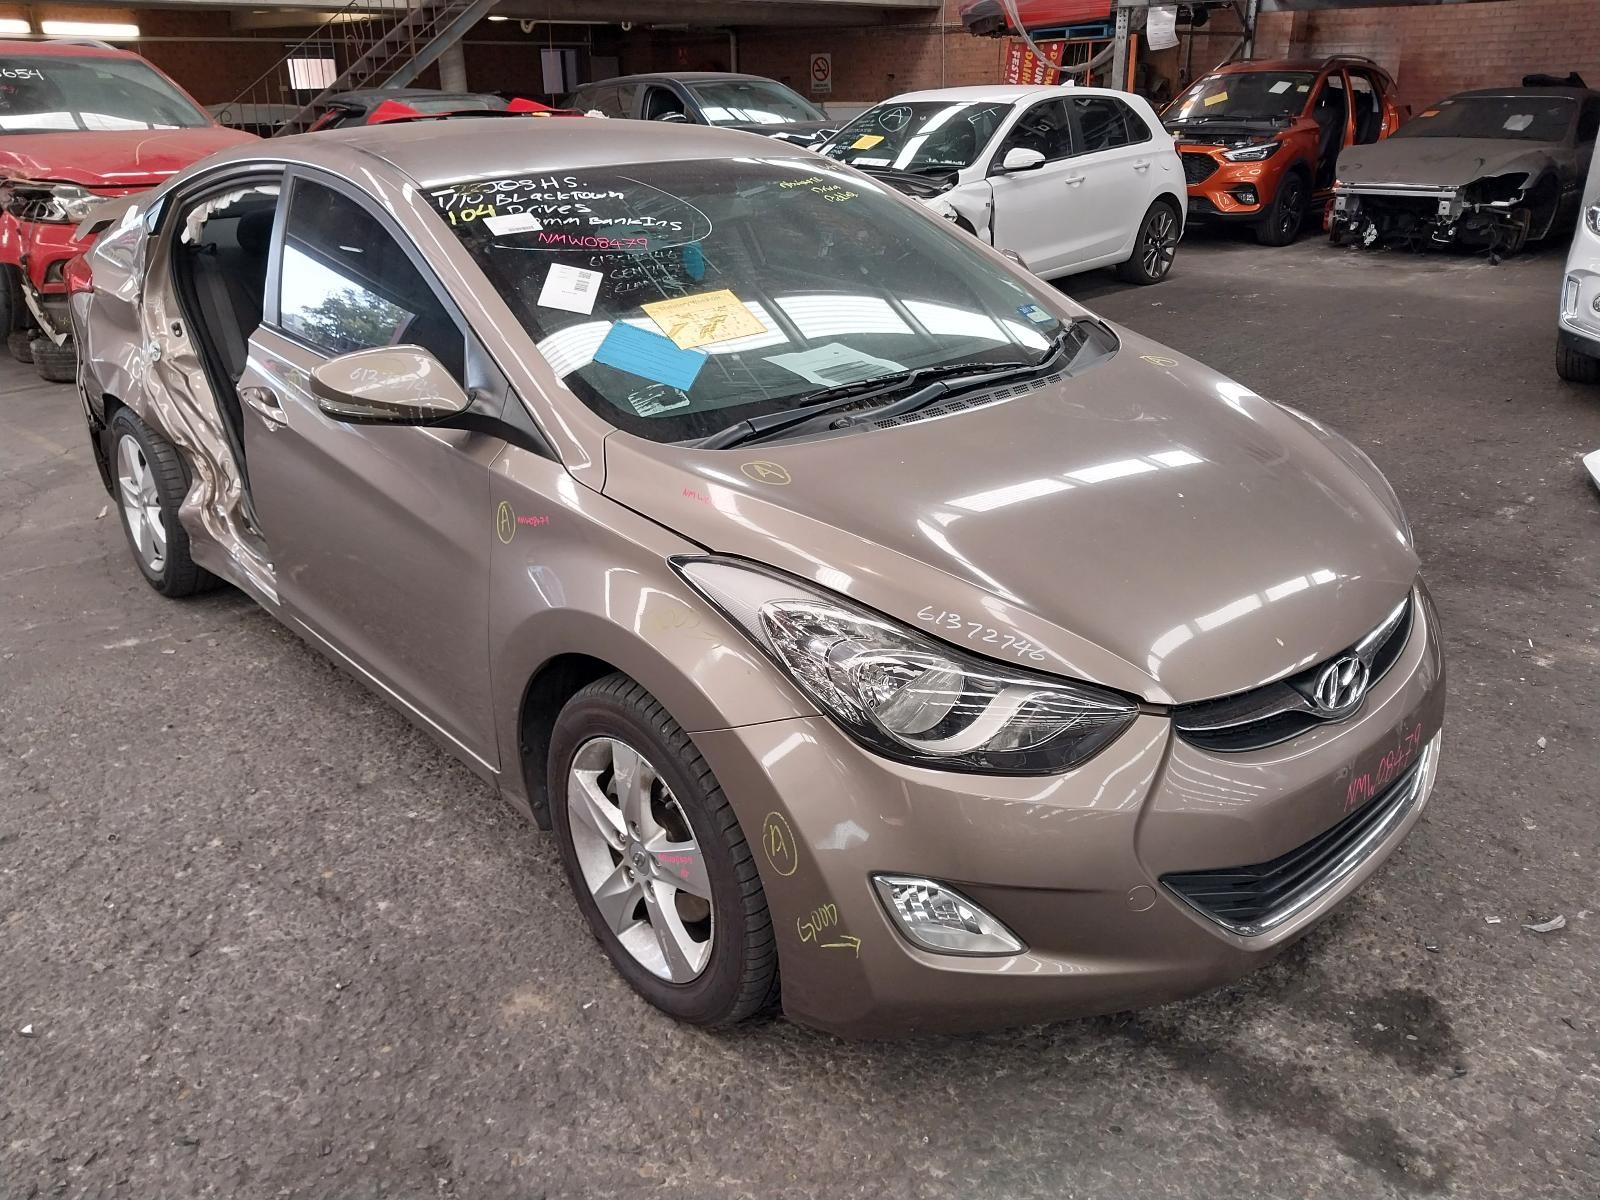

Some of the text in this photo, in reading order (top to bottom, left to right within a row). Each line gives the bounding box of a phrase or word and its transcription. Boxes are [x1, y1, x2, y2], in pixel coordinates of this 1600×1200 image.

[0, 67, 44, 81] 654
[447, 204, 497, 226] 104
[535, 216, 580, 227] omm
[538, 231, 649, 251] NMW08479
[916, 605, 1046, 661] 61372746
